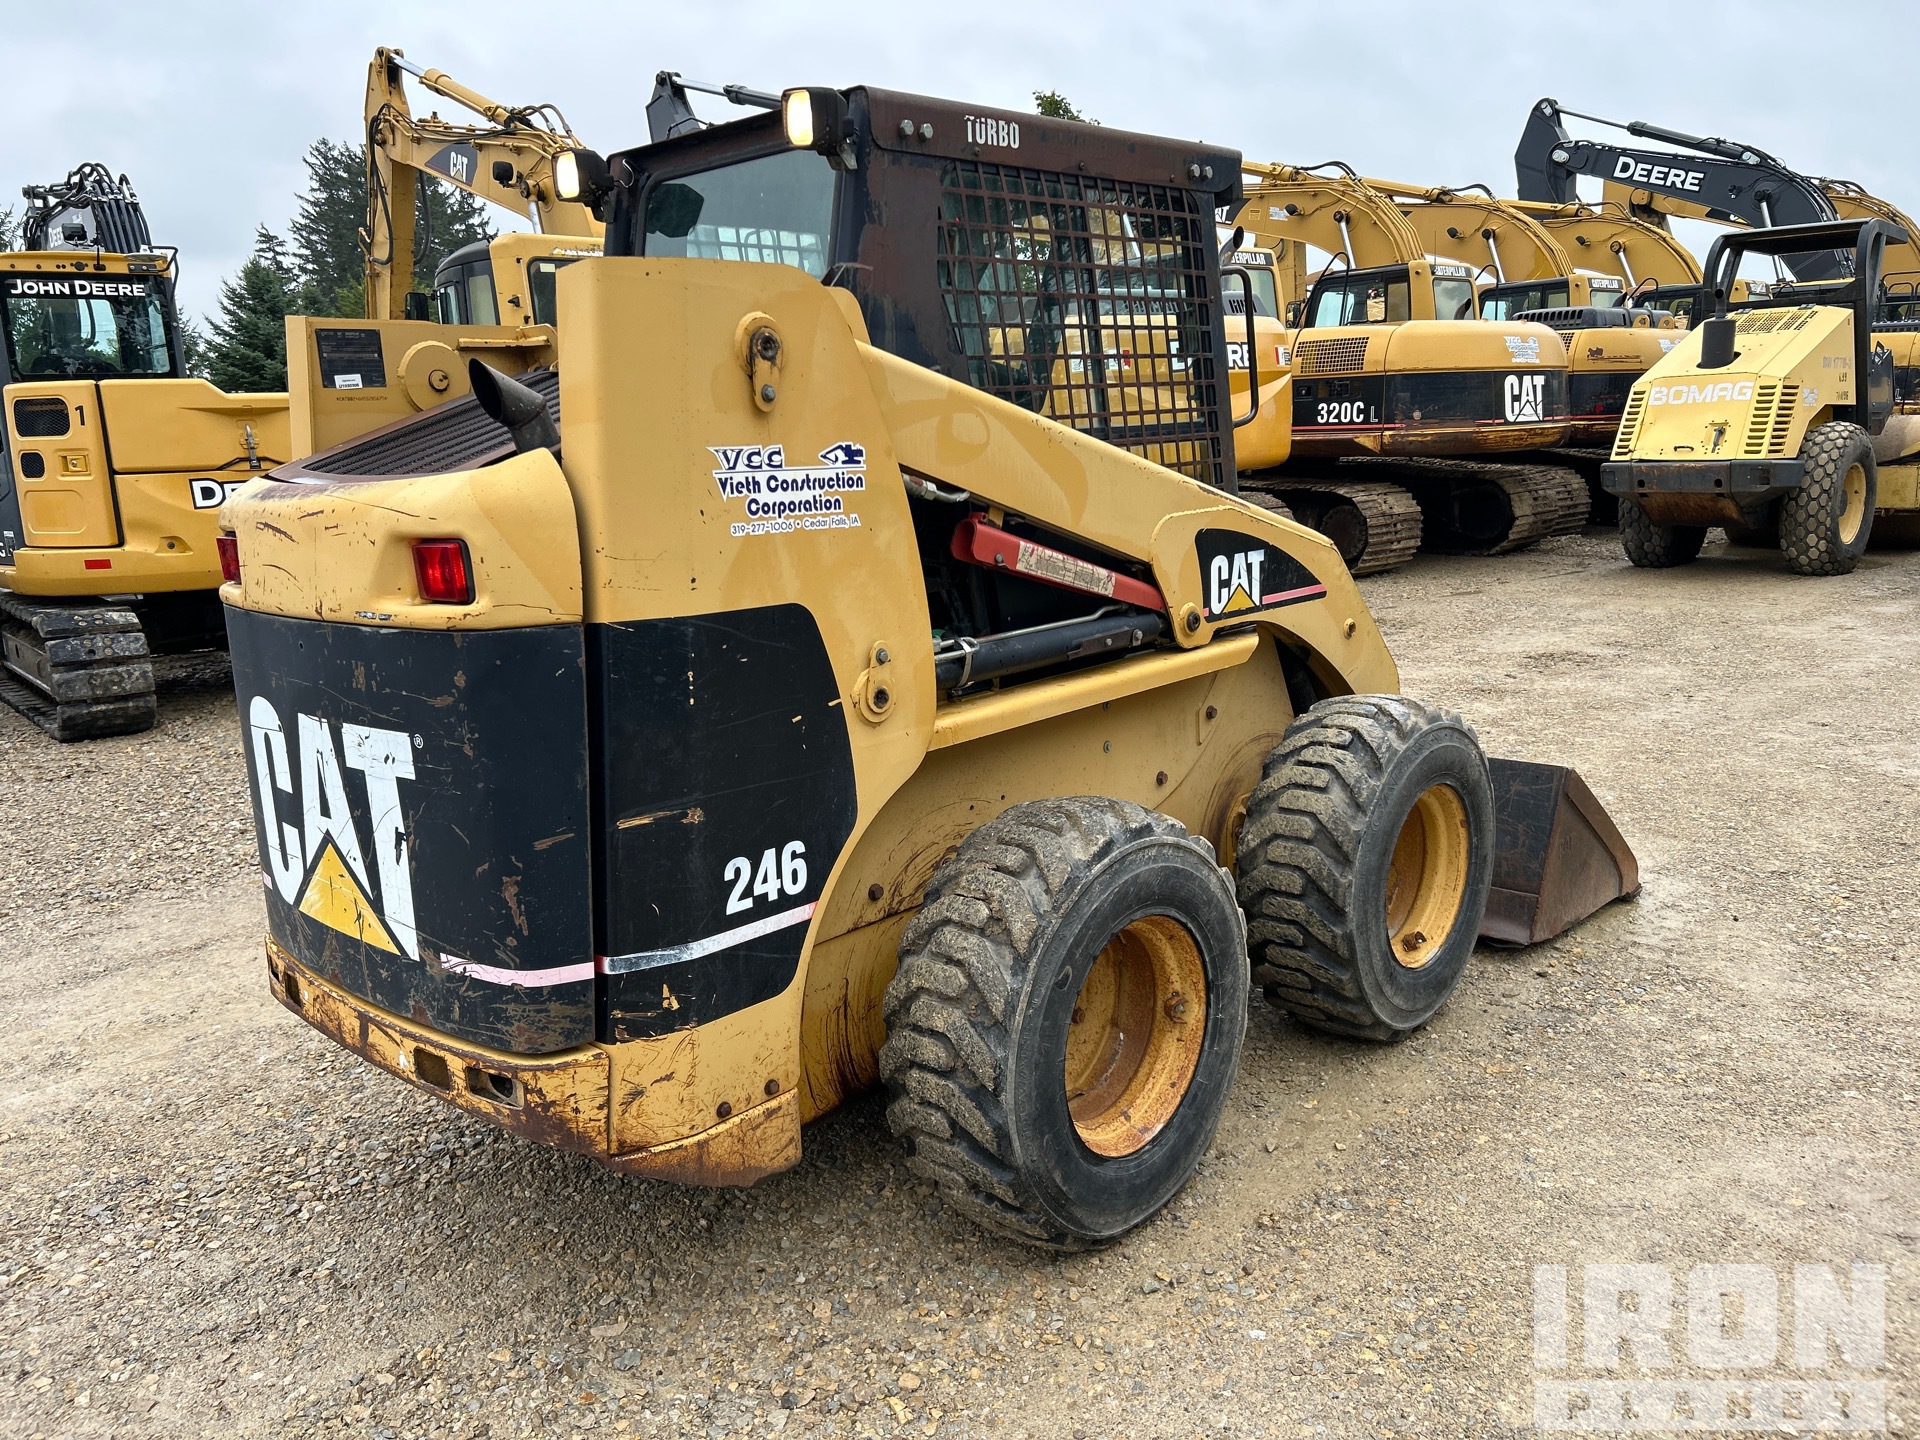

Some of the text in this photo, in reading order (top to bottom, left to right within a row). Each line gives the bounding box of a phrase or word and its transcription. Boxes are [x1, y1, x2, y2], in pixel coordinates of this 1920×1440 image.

[964, 115, 1020, 149] TURBO
[450, 151, 468, 182] CAT
[1613, 155, 1704, 192] DEERE
[11, 279, 145, 297] JOHN DEERE
[1504, 374, 1545, 422] CAT
[1648, 381, 1755, 406] BOMAG
[74, 405, 86, 426] 1
[1317, 401, 1379, 423] 320C L
[712, 447, 783, 470] VCC
[717, 471, 864, 496] Vieth Construction
[746, 494, 842, 518] Corporation
[731, 515, 860, 535] 319-277-1006 Cedar Falls, IA
[1210, 549, 1265, 615] CAT
[250, 696, 420, 961] CAT
[723, 840, 808, 916] 246
